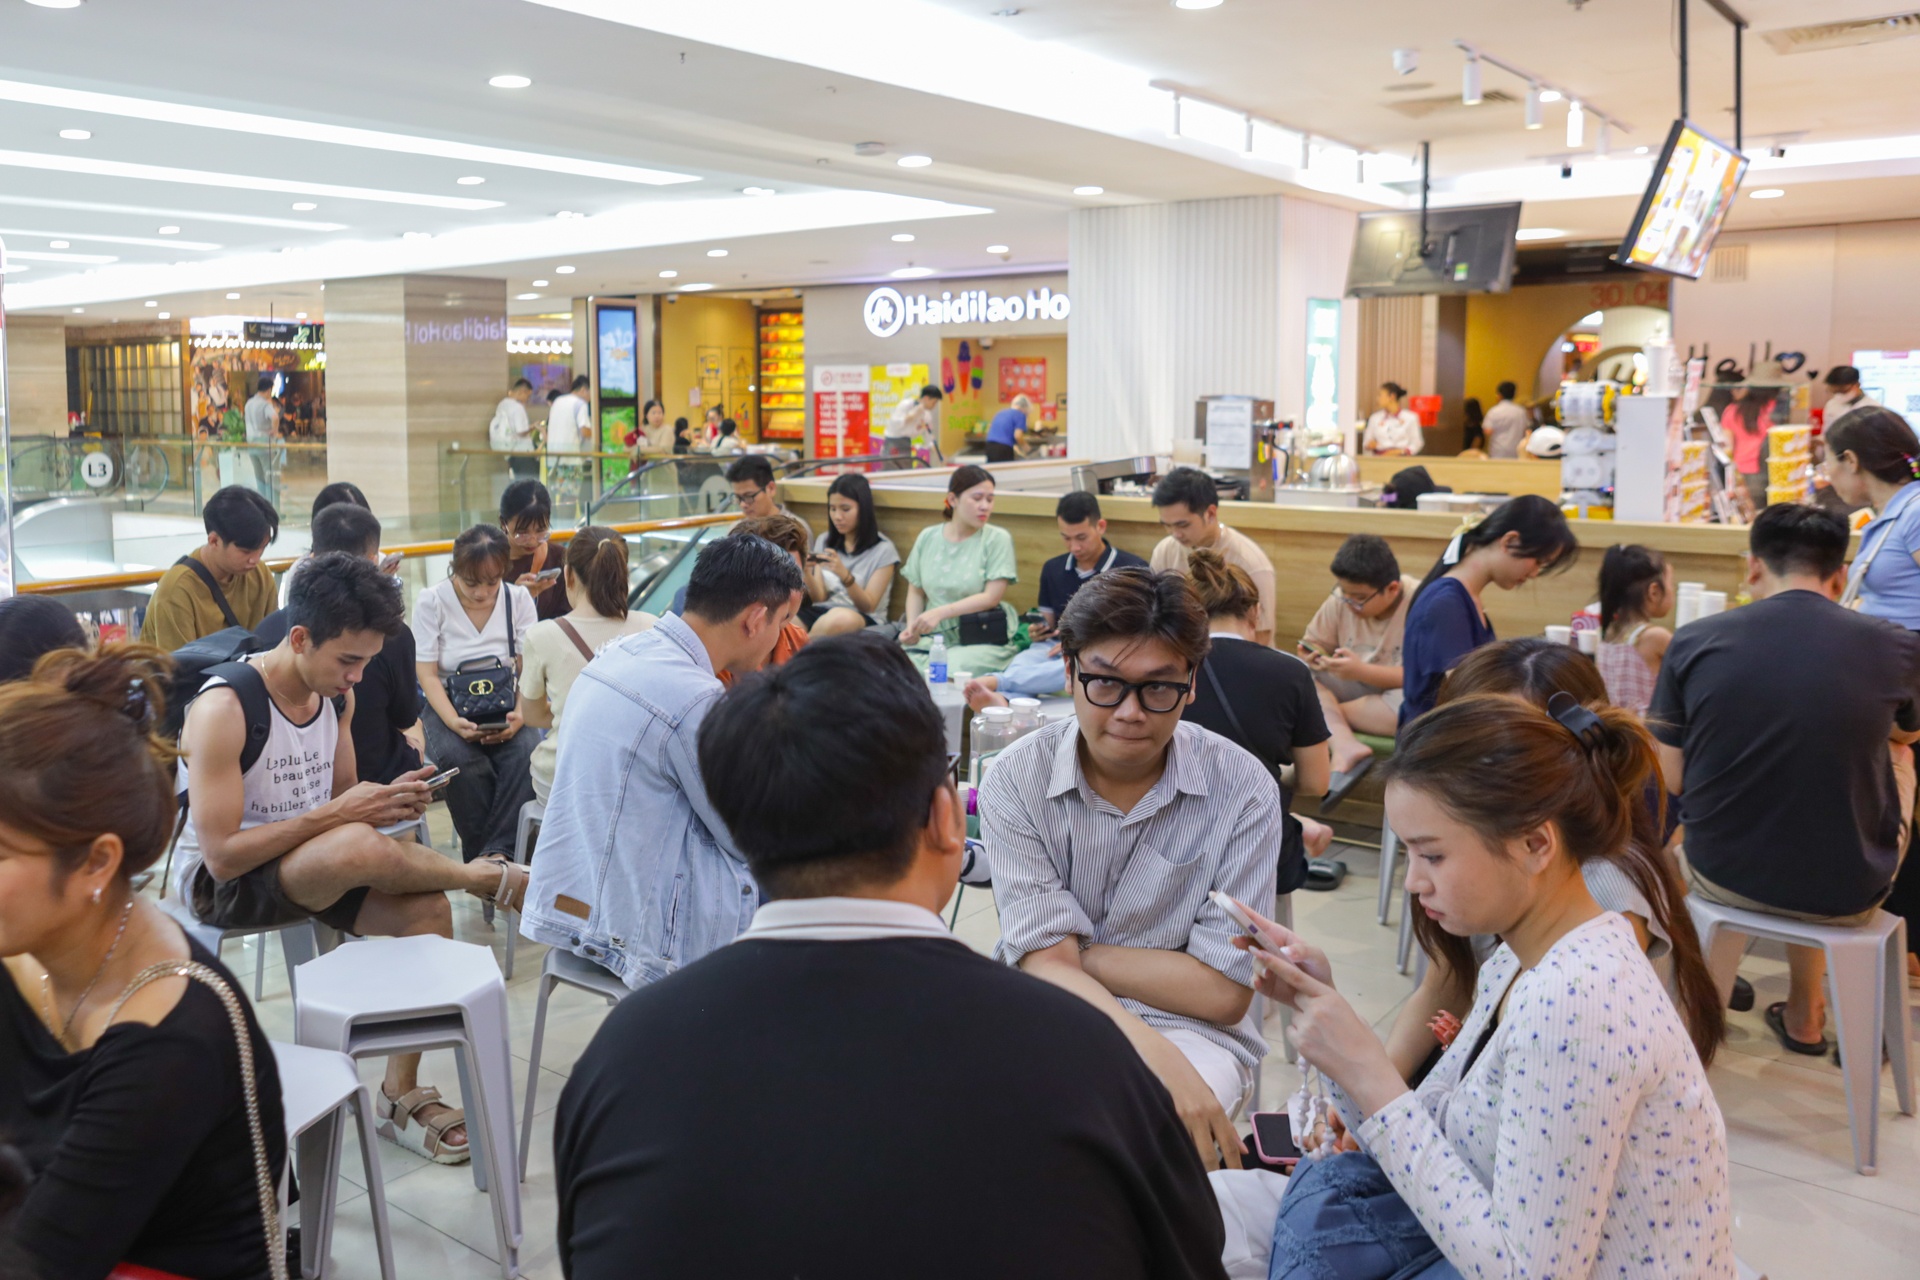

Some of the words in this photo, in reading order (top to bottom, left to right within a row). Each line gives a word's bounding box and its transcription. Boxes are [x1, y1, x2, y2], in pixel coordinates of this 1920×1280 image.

[905, 290, 1024, 325] Haidilao
[88, 463, 106, 478] L3
[251, 800, 306, 814] habiller
